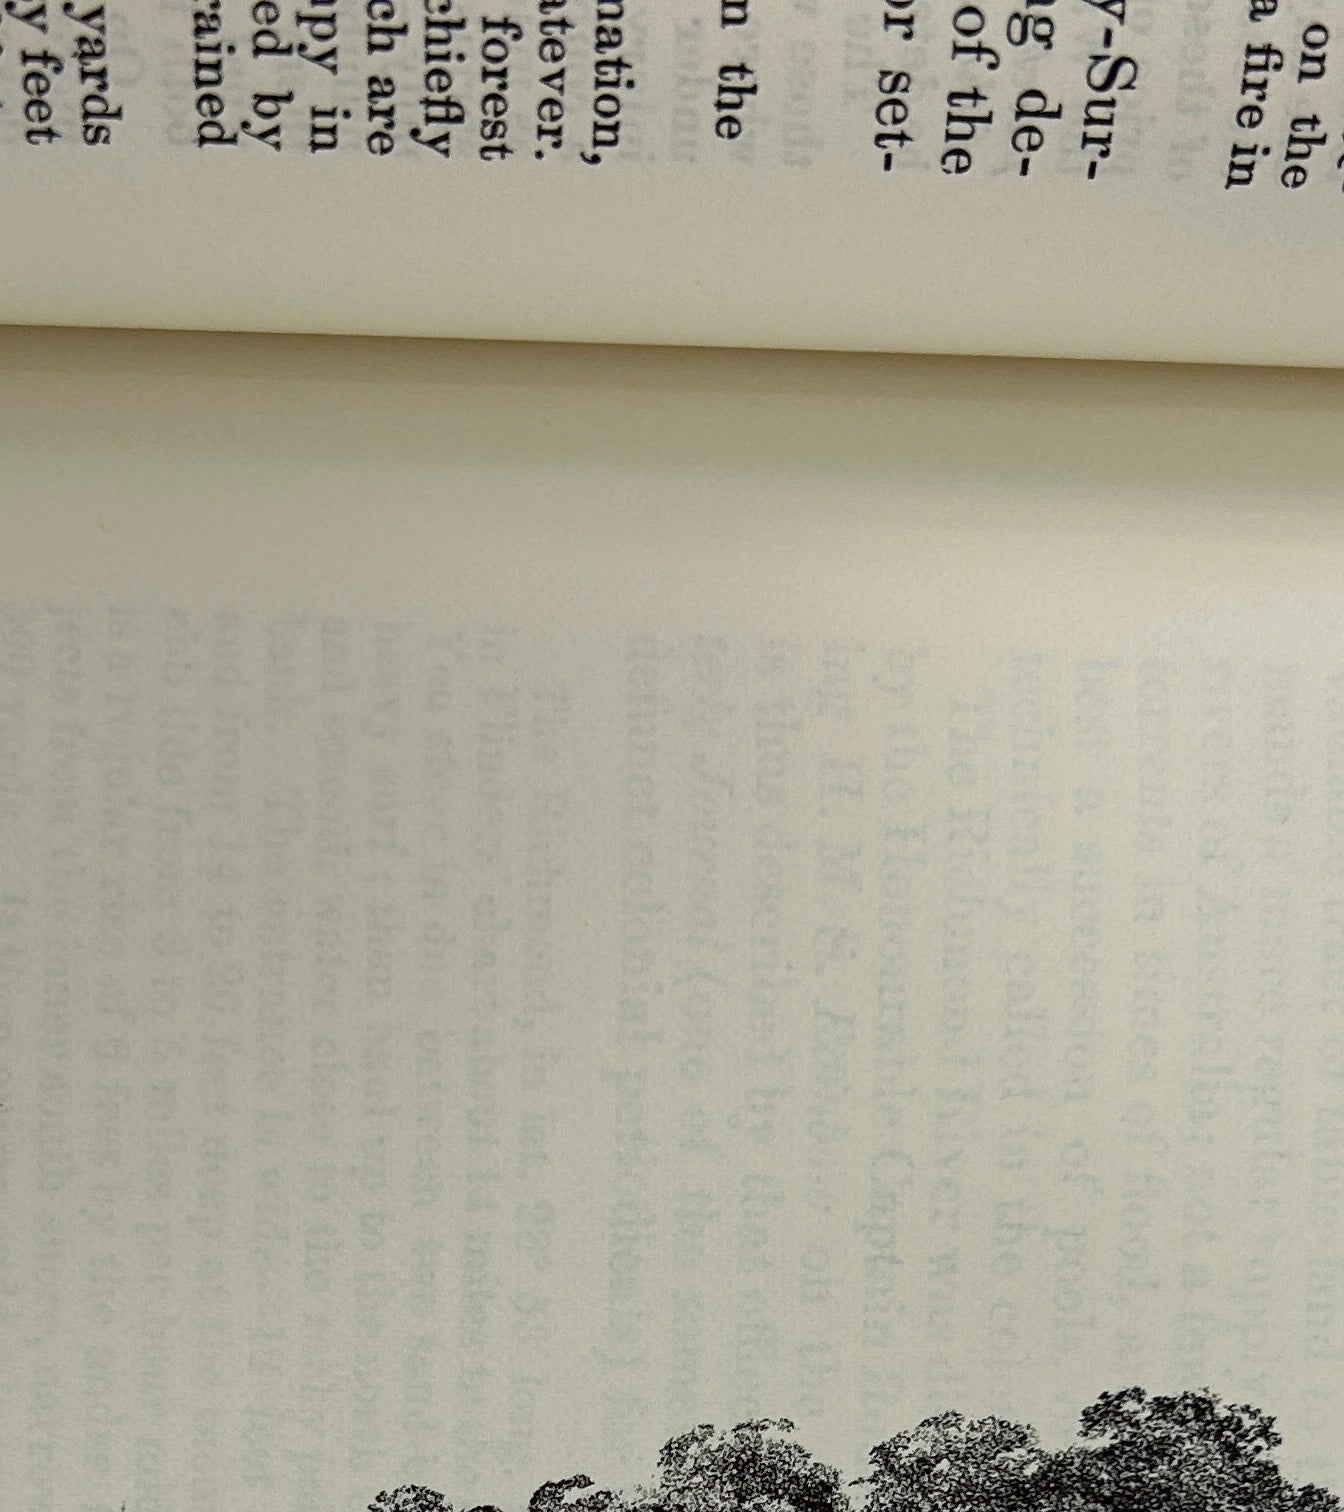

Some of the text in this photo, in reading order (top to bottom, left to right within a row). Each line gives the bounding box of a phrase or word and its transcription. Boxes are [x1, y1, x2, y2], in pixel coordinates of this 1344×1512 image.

[20, 49, 64, 145] feet
[62, 0, 123, 146] yards
[240, 91, 294, 151] by
[296, 0, 352, 154] py in
[366, 75, 396, 156] are
[479, 16, 523, 161] forest
[713, 62, 758, 140] the
[874, 69, 915, 171] set-
[940, 4, 1000, 174] of the
[1006, 0, 1063, 176] g de-
[1236, 42, 1284, 129] fire
[1281, 22, 1329, 189] on the
[1224, 142, 1271, 190] in
